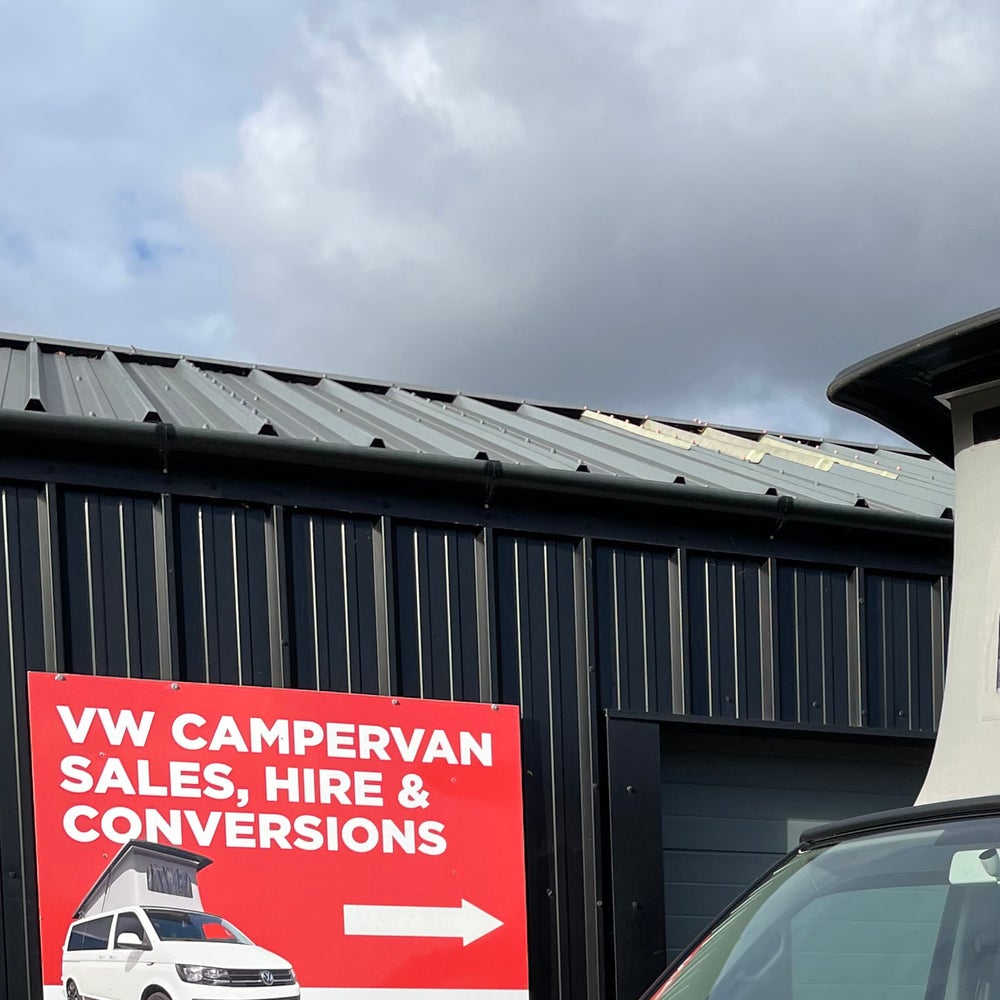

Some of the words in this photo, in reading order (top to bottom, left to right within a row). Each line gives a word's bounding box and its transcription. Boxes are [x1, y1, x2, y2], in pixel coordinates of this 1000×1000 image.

[56, 705, 156, 747] VW
[171, 712, 493, 767] CAMPERVAN
[59, 755, 249, 808] SALES,
[265, 765, 384, 807] HIRE
[397, 773, 430, 810] &
[62, 804, 447, 856] CONVERSIONS
